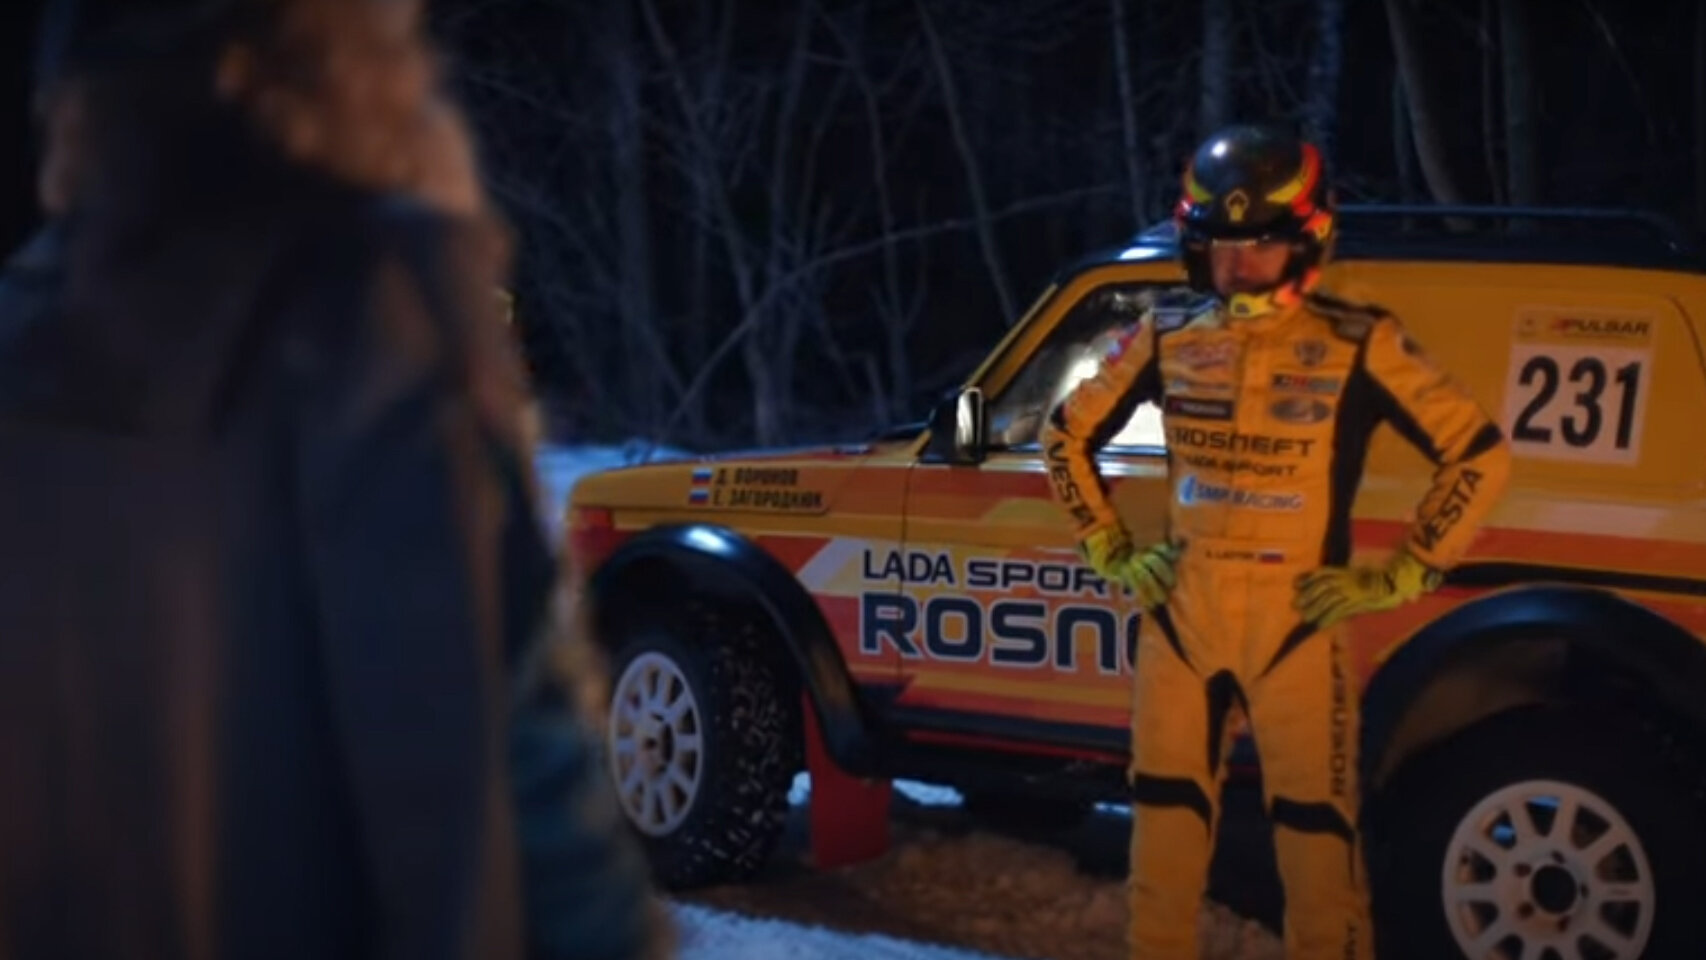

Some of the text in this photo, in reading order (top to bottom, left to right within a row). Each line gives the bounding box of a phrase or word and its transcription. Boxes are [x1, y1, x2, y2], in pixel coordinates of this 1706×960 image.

[1511, 355, 1642, 450] 231
[1411, 467, 1484, 552] VESTA
[864, 549, 1132, 596] LADA SPOR
